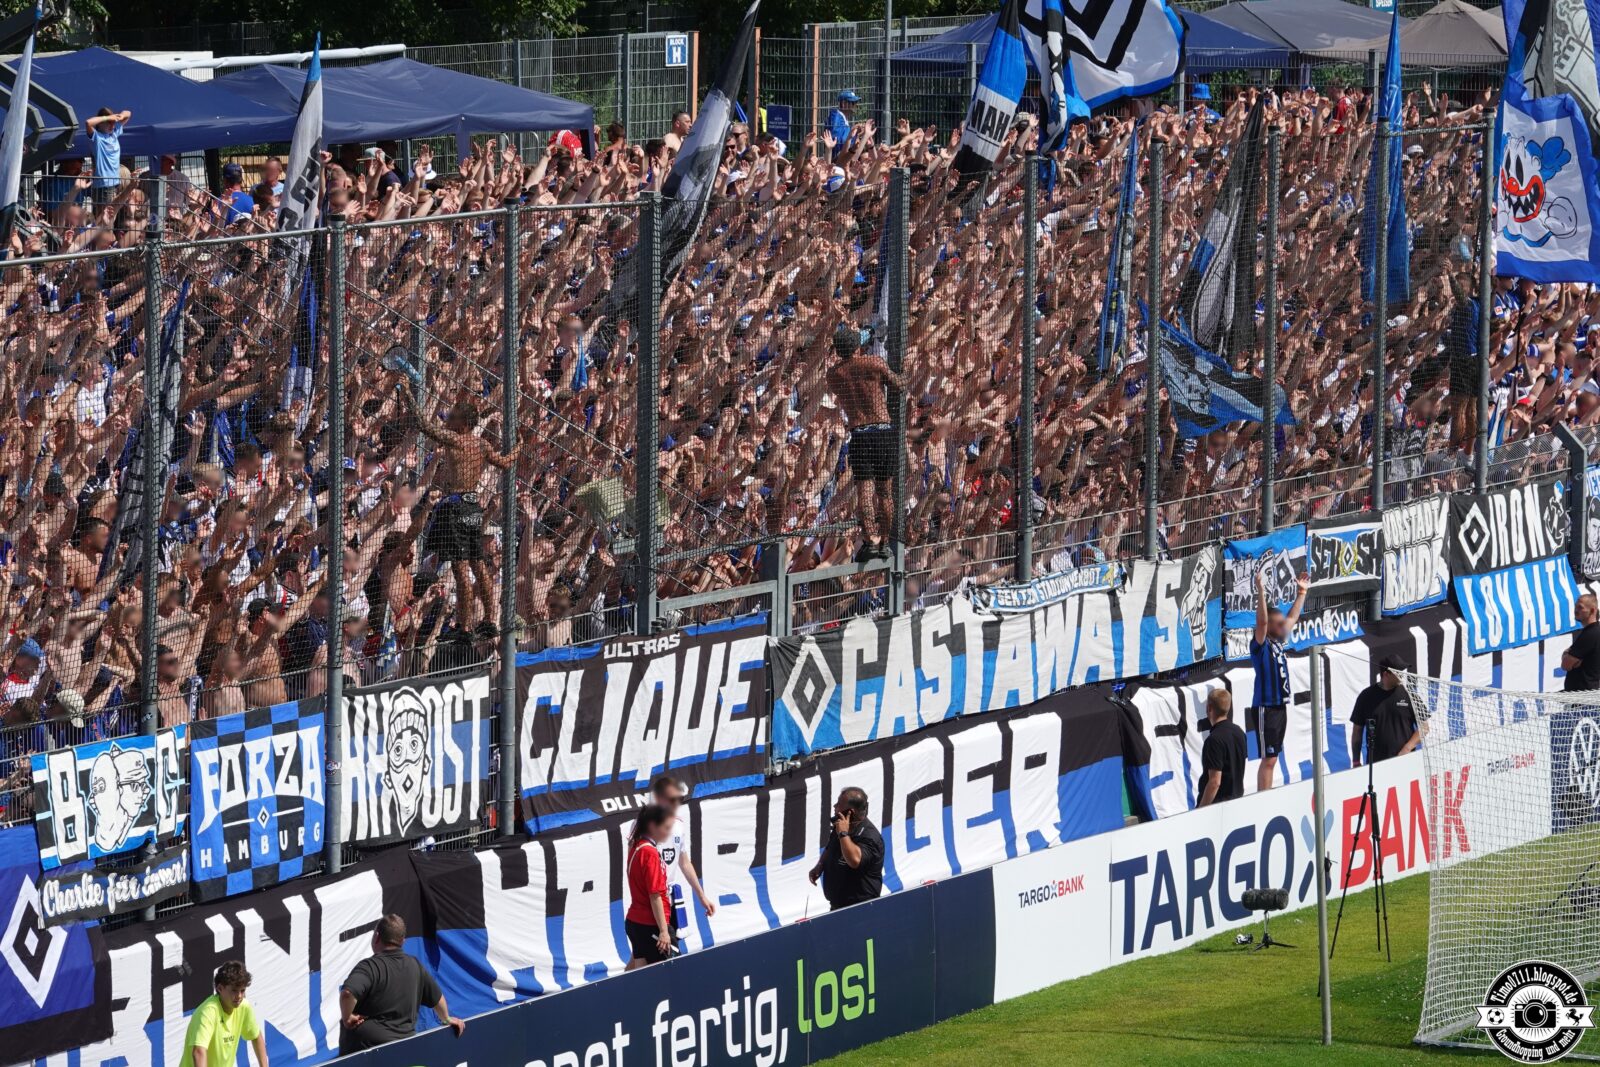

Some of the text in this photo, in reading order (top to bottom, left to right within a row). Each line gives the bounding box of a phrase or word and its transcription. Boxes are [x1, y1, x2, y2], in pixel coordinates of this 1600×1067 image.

[670, 38, 684, 46] BLOCK
[672, 46, 682, 64] H
[1488, 484, 1546, 569] IRON
[1463, 558, 1576, 650] LOYALTY
[604, 633, 681, 660] ULTRAS
[840, 559, 1182, 744] CASTAWAYS
[194, 725, 324, 835] FORZA
[601, 795, 632, 813] DU
[201, 821, 321, 868] HAMBURG
[664, 851, 674, 861] BP
[43, 848, 188, 917] Charlie für immer!
[652, 975, 789, 1067] fertig,
[797, 938, 875, 1033] los!
